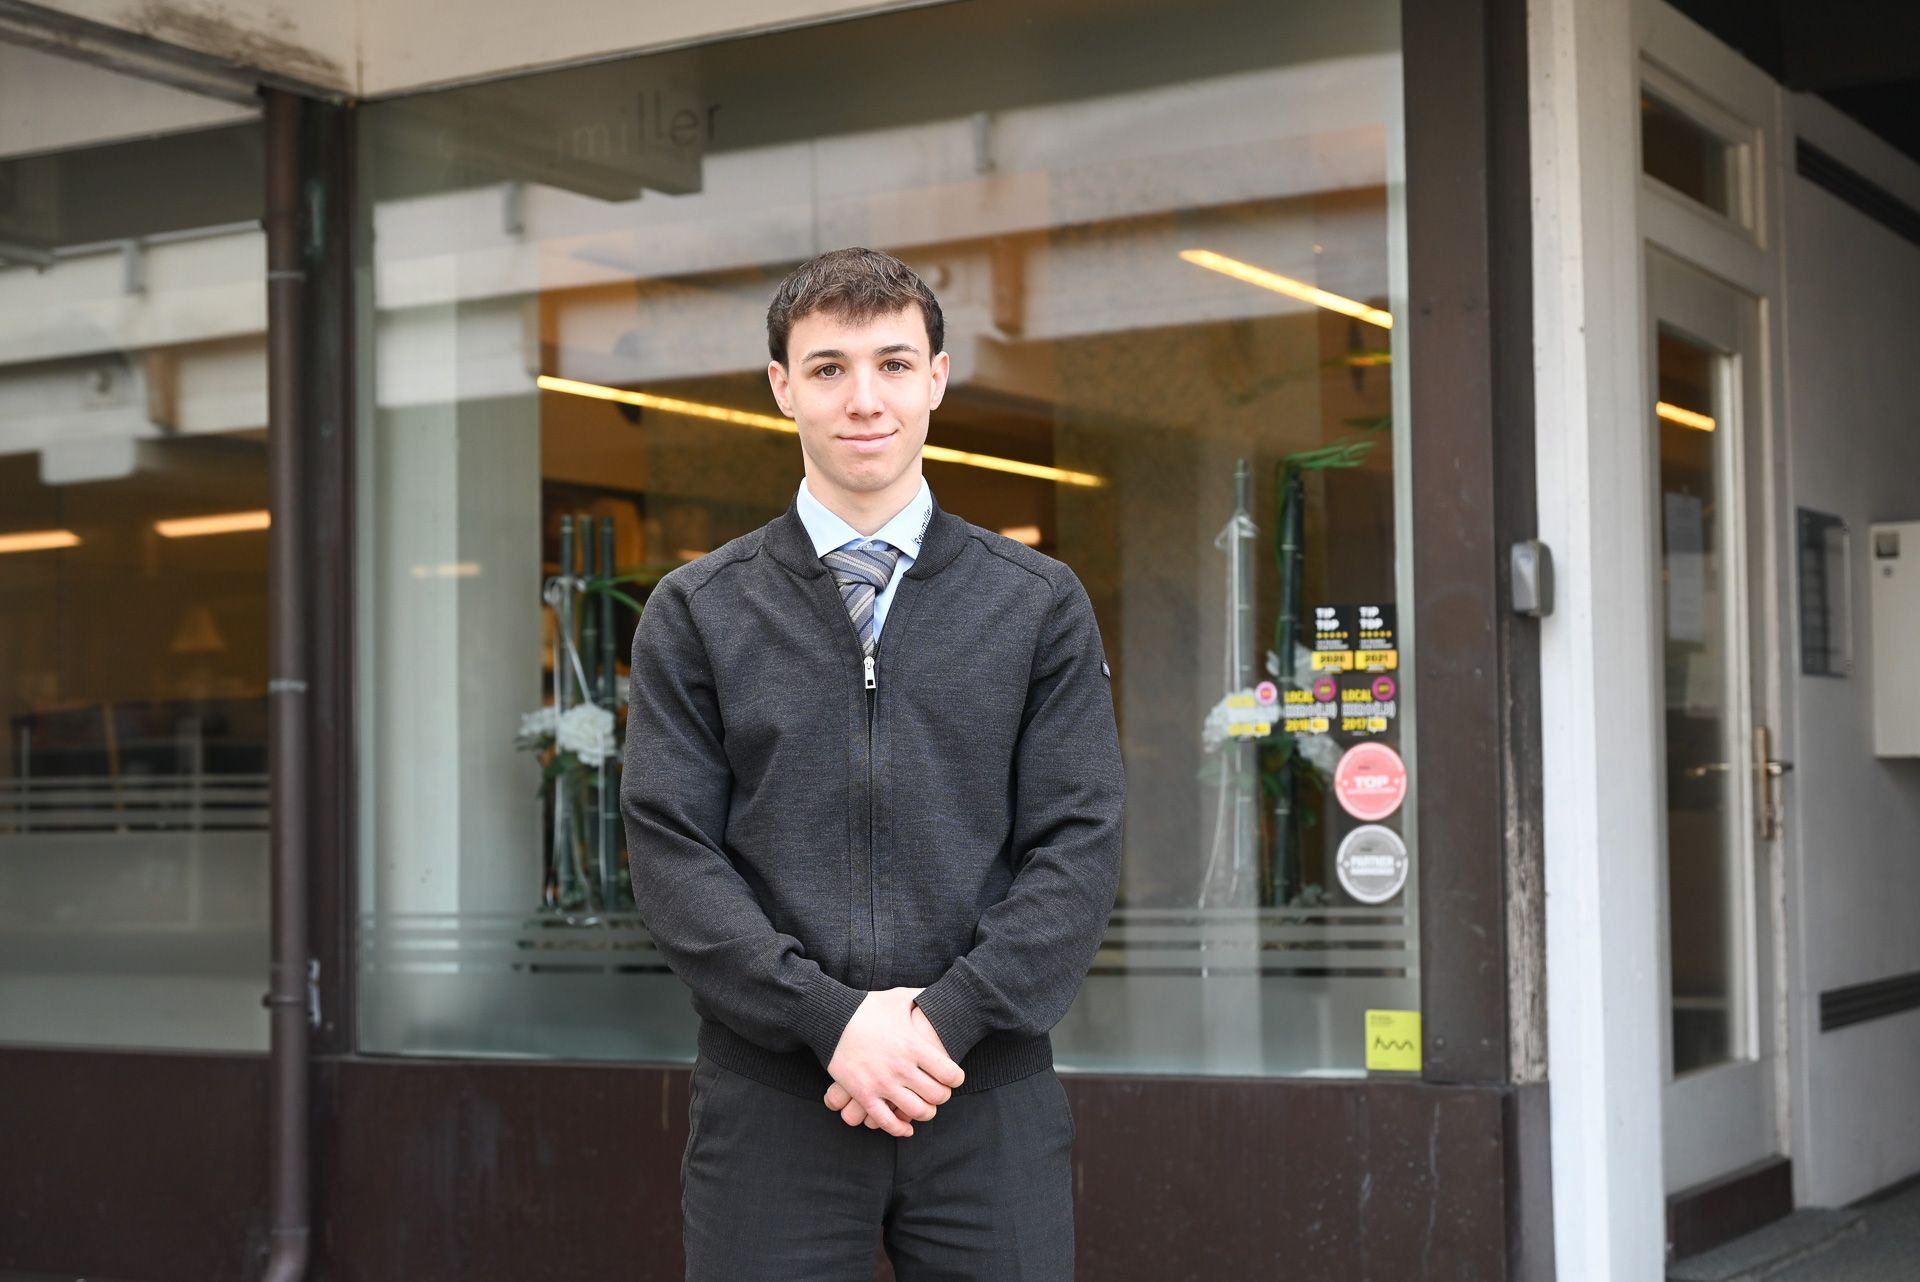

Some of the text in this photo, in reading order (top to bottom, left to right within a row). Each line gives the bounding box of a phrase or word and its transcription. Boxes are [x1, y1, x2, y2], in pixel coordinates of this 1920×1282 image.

[1284, 690, 1314, 703] LOCAL
[1341, 688, 1373, 702] LOCAL
[1354, 776, 1389, 788] TOP
